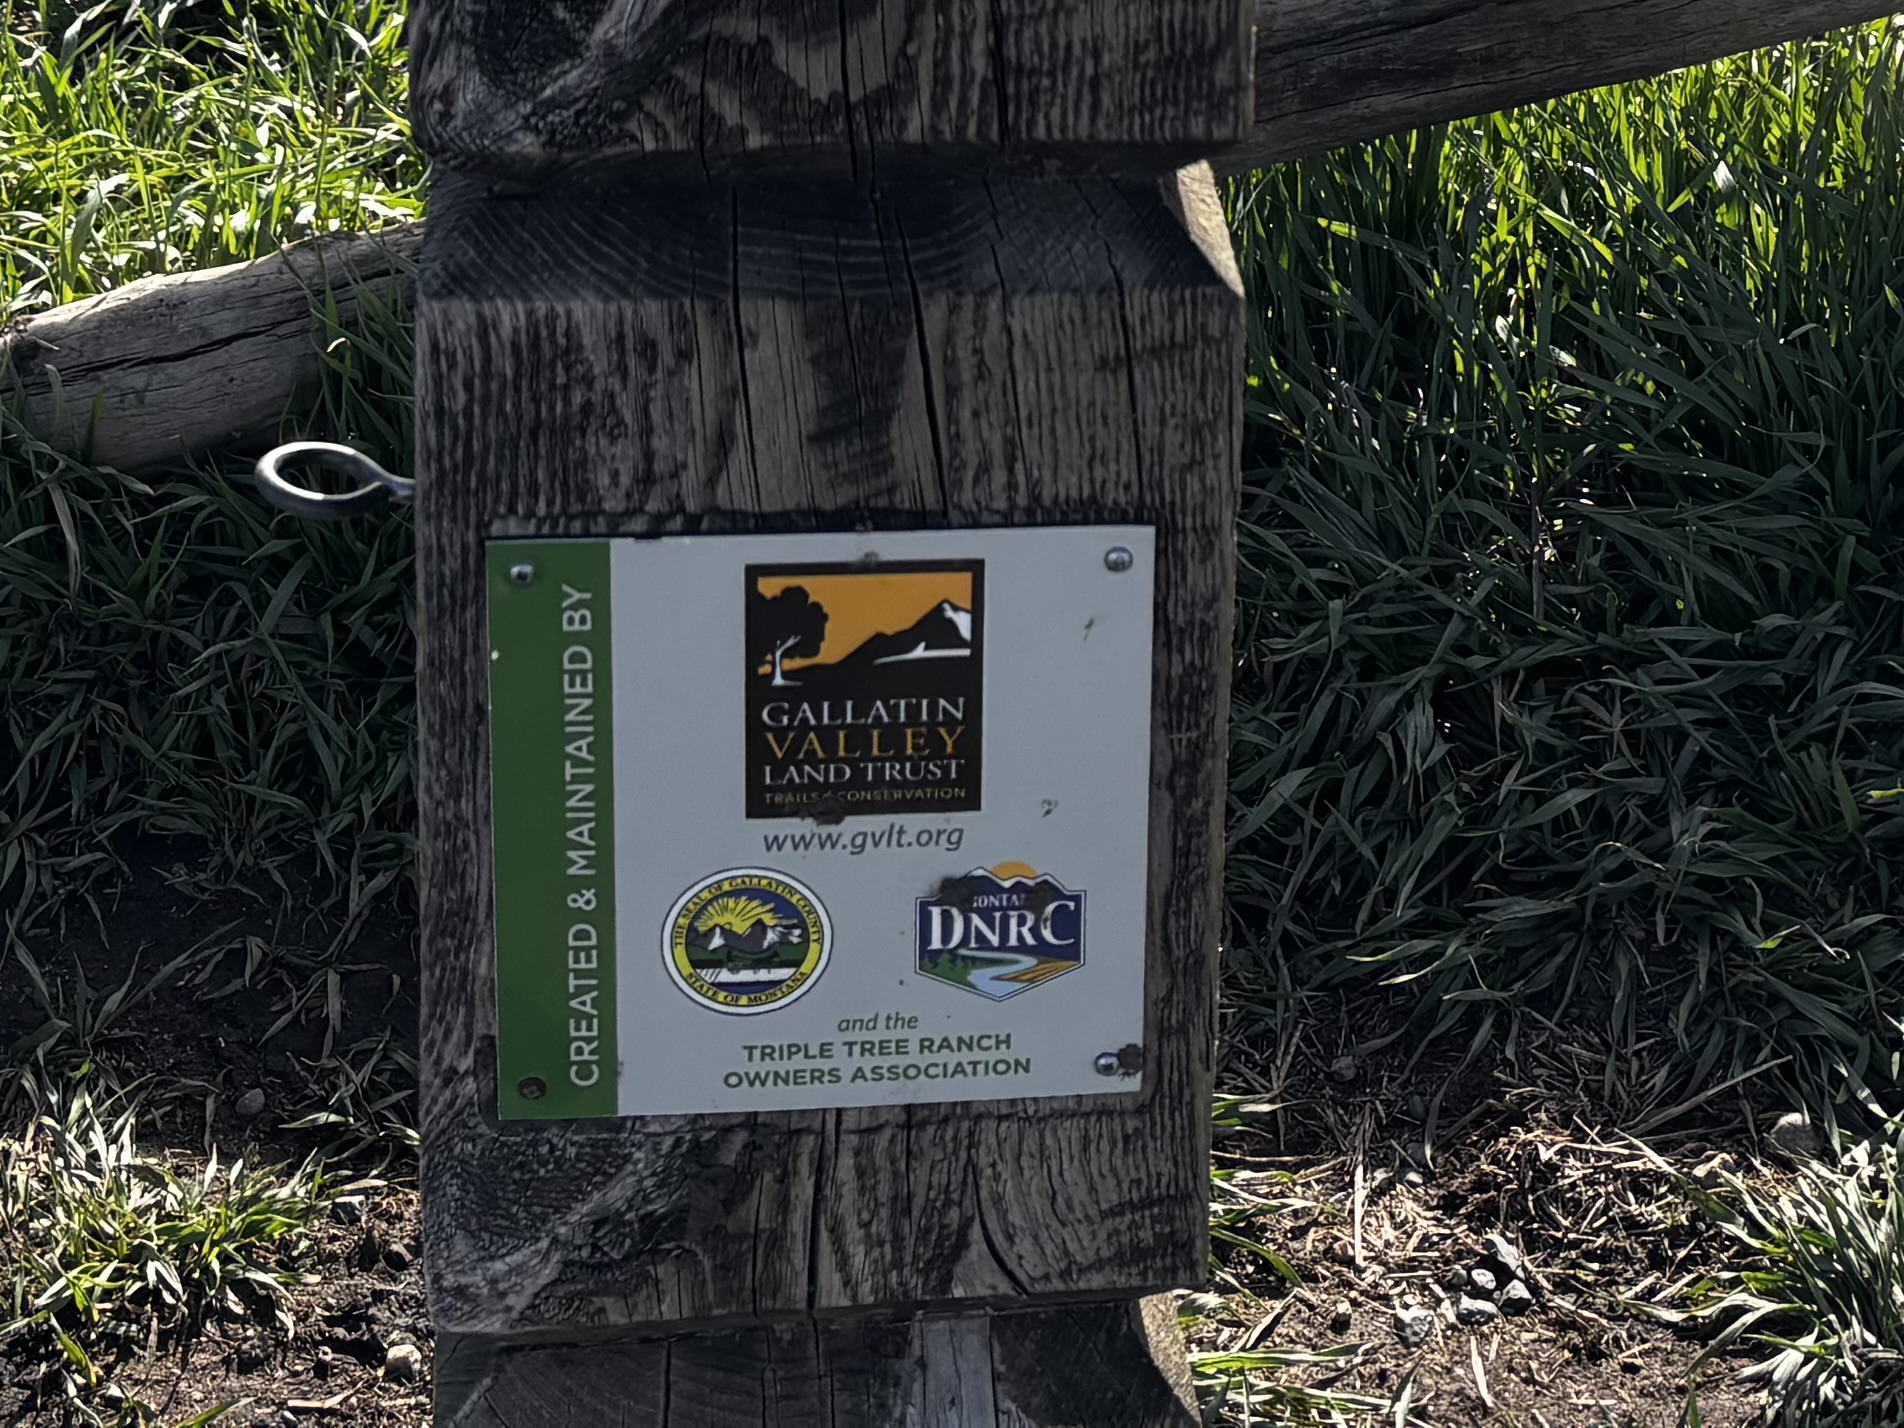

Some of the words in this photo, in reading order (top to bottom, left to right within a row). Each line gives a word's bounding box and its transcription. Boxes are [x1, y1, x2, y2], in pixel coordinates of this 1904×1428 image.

[560, 584, 593, 632] BY
[762, 697, 965, 727] GALLATIN
[764, 726, 965, 760] VALLEY
[562, 645, 596, 876] MAINTAINED
[764, 763, 851, 785] LAND
[860, 759, 965, 781] TRUST
[763, 822, 964, 855] www.gvlt.org
[567, 889, 597, 911] &
[927, 900, 1076, 950] DNRC
[568, 923, 599, 1087] CREATED
[838, 1012, 877, 1032] and
[885, 1012, 919, 1030] the
[742, 1041, 834, 1062] TRIPLE
[842, 1038, 910, 1057] TREE
[919, 1033, 1011, 1054] RANCH
[723, 1067, 842, 1088] OWNERS
[850, 1057, 1031, 1083] ASSOCIATION
